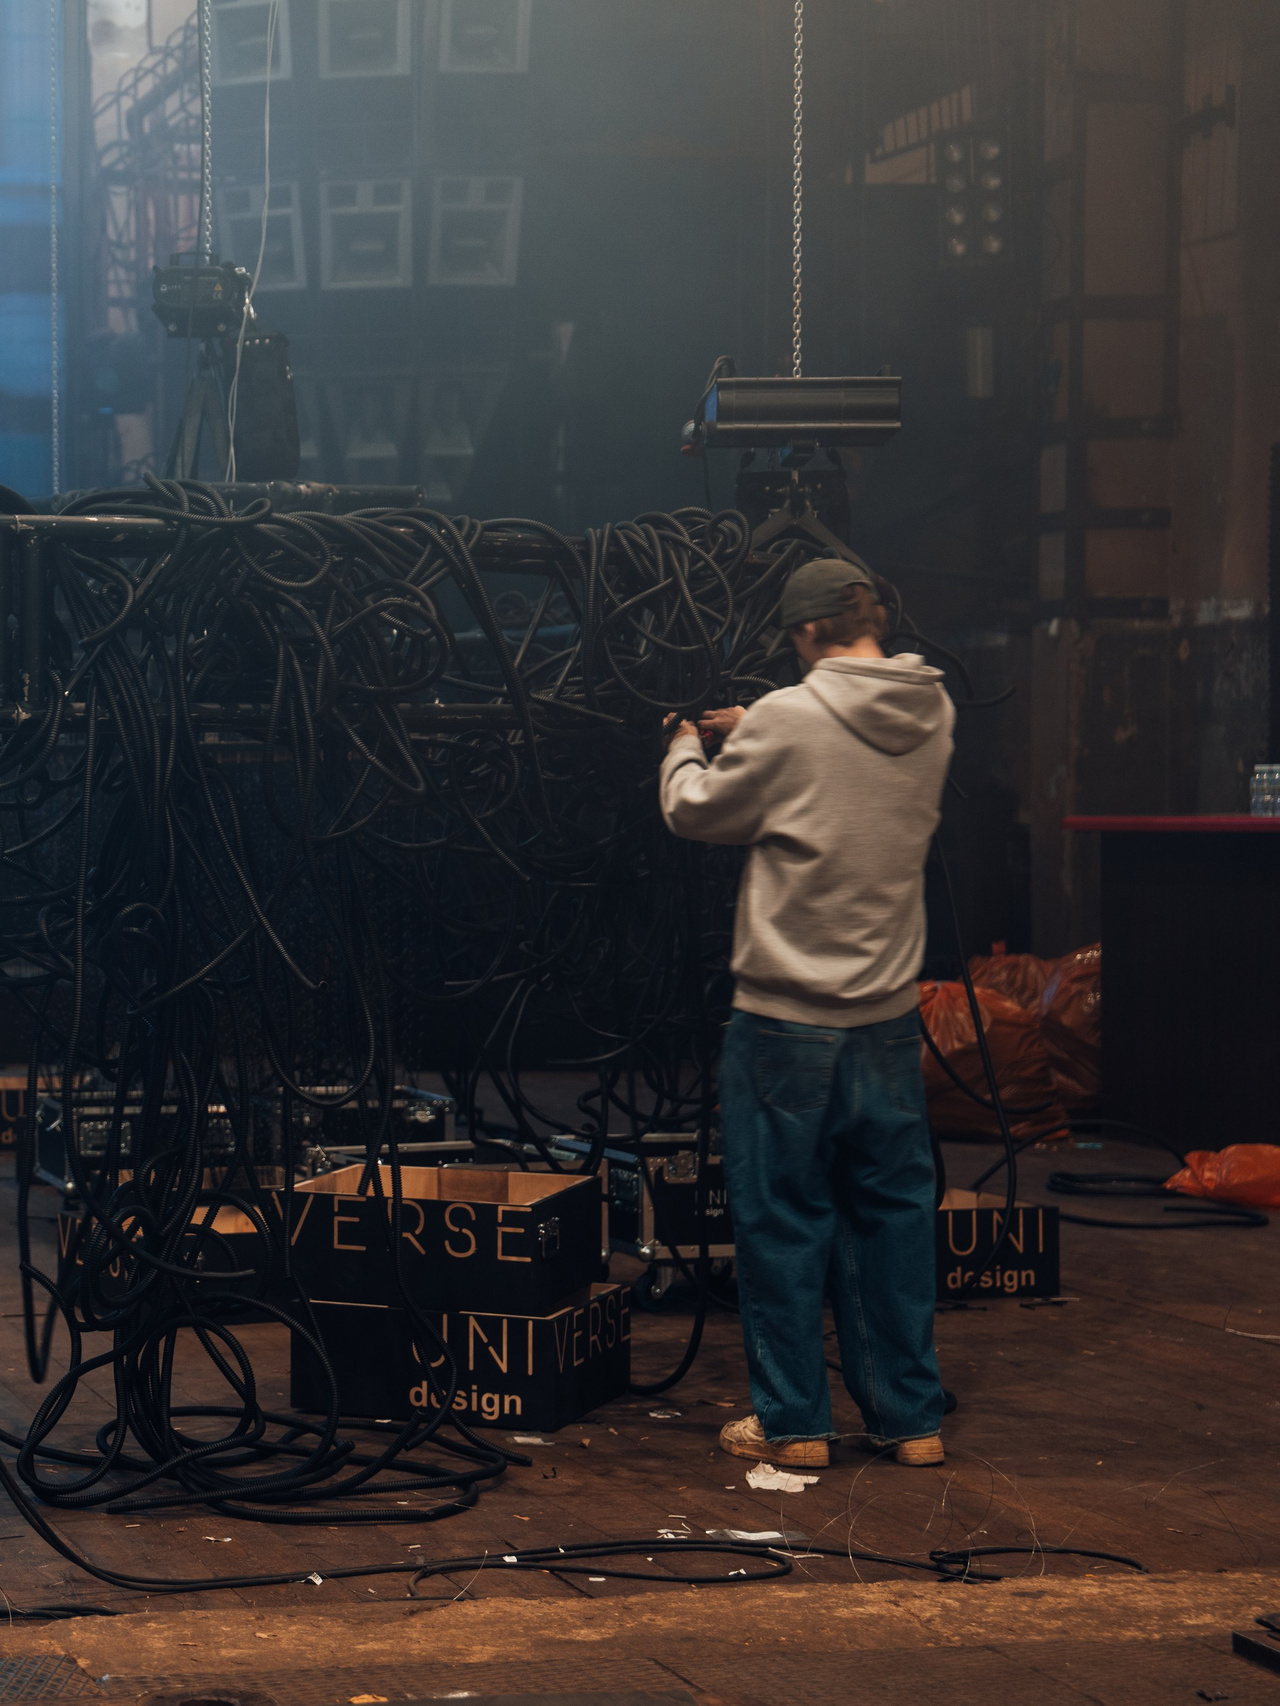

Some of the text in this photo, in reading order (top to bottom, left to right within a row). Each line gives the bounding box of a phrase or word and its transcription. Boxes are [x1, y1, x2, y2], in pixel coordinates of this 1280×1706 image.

[260, 1190, 533, 1264] VERSE
[947, 1207, 1045, 1257] UNI
[410, 1312, 534, 1377] UNI
[554, 1286, 632, 1375] VERSE
